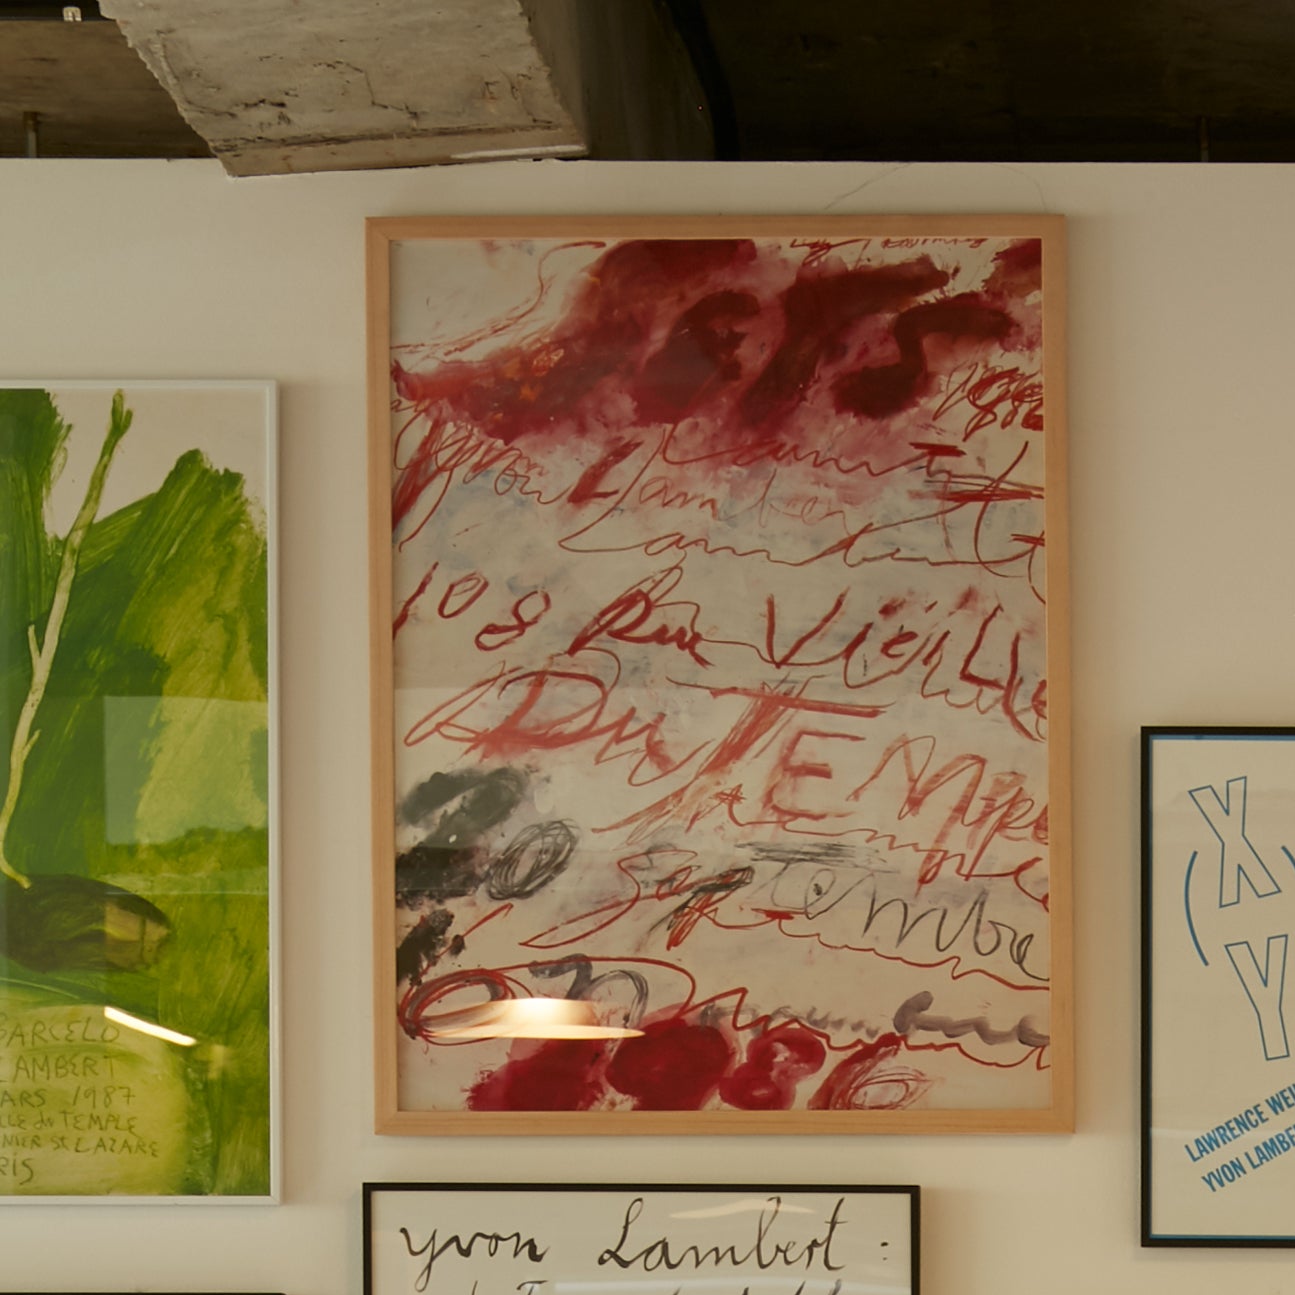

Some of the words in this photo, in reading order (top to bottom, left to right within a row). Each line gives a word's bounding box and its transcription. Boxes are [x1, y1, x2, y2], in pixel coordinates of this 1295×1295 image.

[0, 1055, 116, 1083] AMBERT
[72, 1086, 136, 1109] 1987
[60, 1110, 137, 1137] TEMPLE
[1184, 1099, 1270, 1164] LAWRENCE
[1201, 1157, 1248, 1194] YVON
[597, 1196, 848, 1273] Lambert
